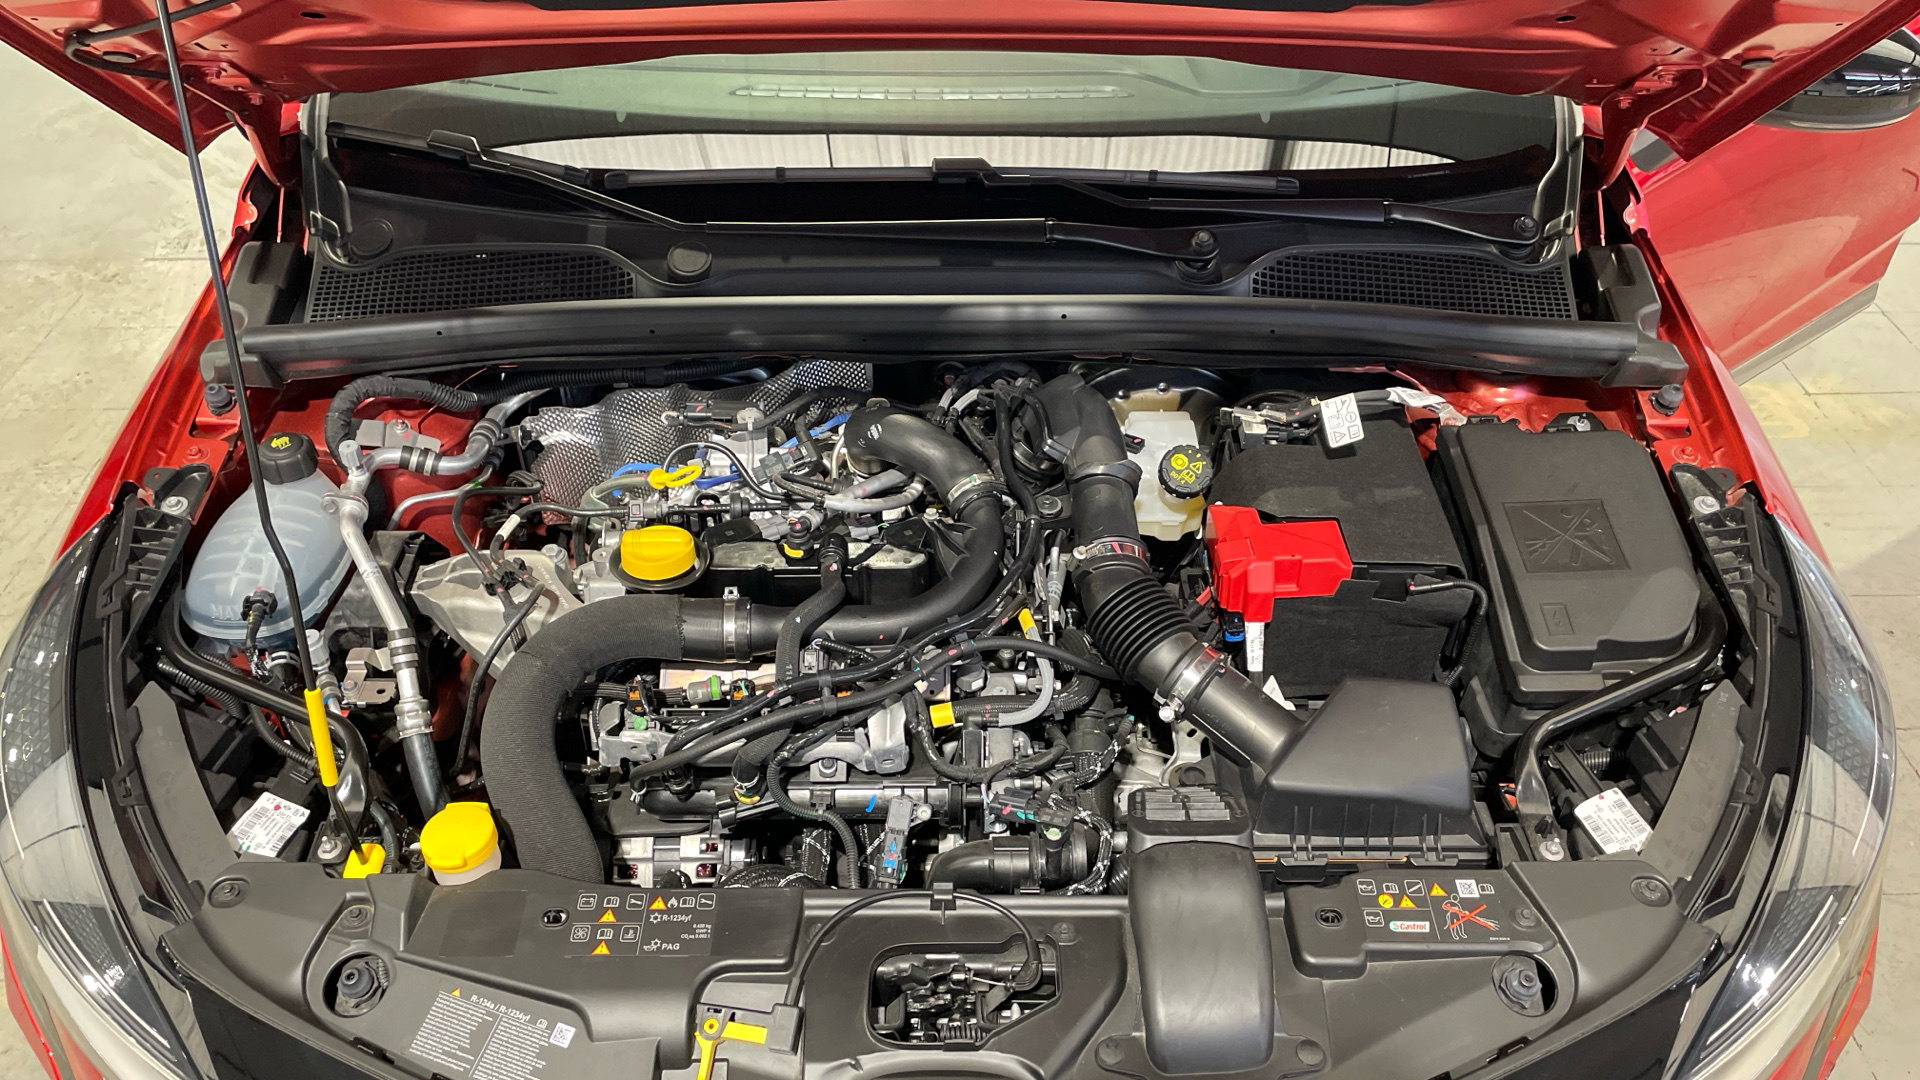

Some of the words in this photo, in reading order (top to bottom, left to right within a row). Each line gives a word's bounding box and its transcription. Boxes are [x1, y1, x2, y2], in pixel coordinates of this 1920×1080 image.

[1170, 471, 1181, 480] DOT
[662, 914, 692, 922] R-1234yf
[1399, 922, 1427, 930] Castrol
[470, 994, 495, 1010] R-134a
[499, 1005, 531, 1022] R-1234yf
